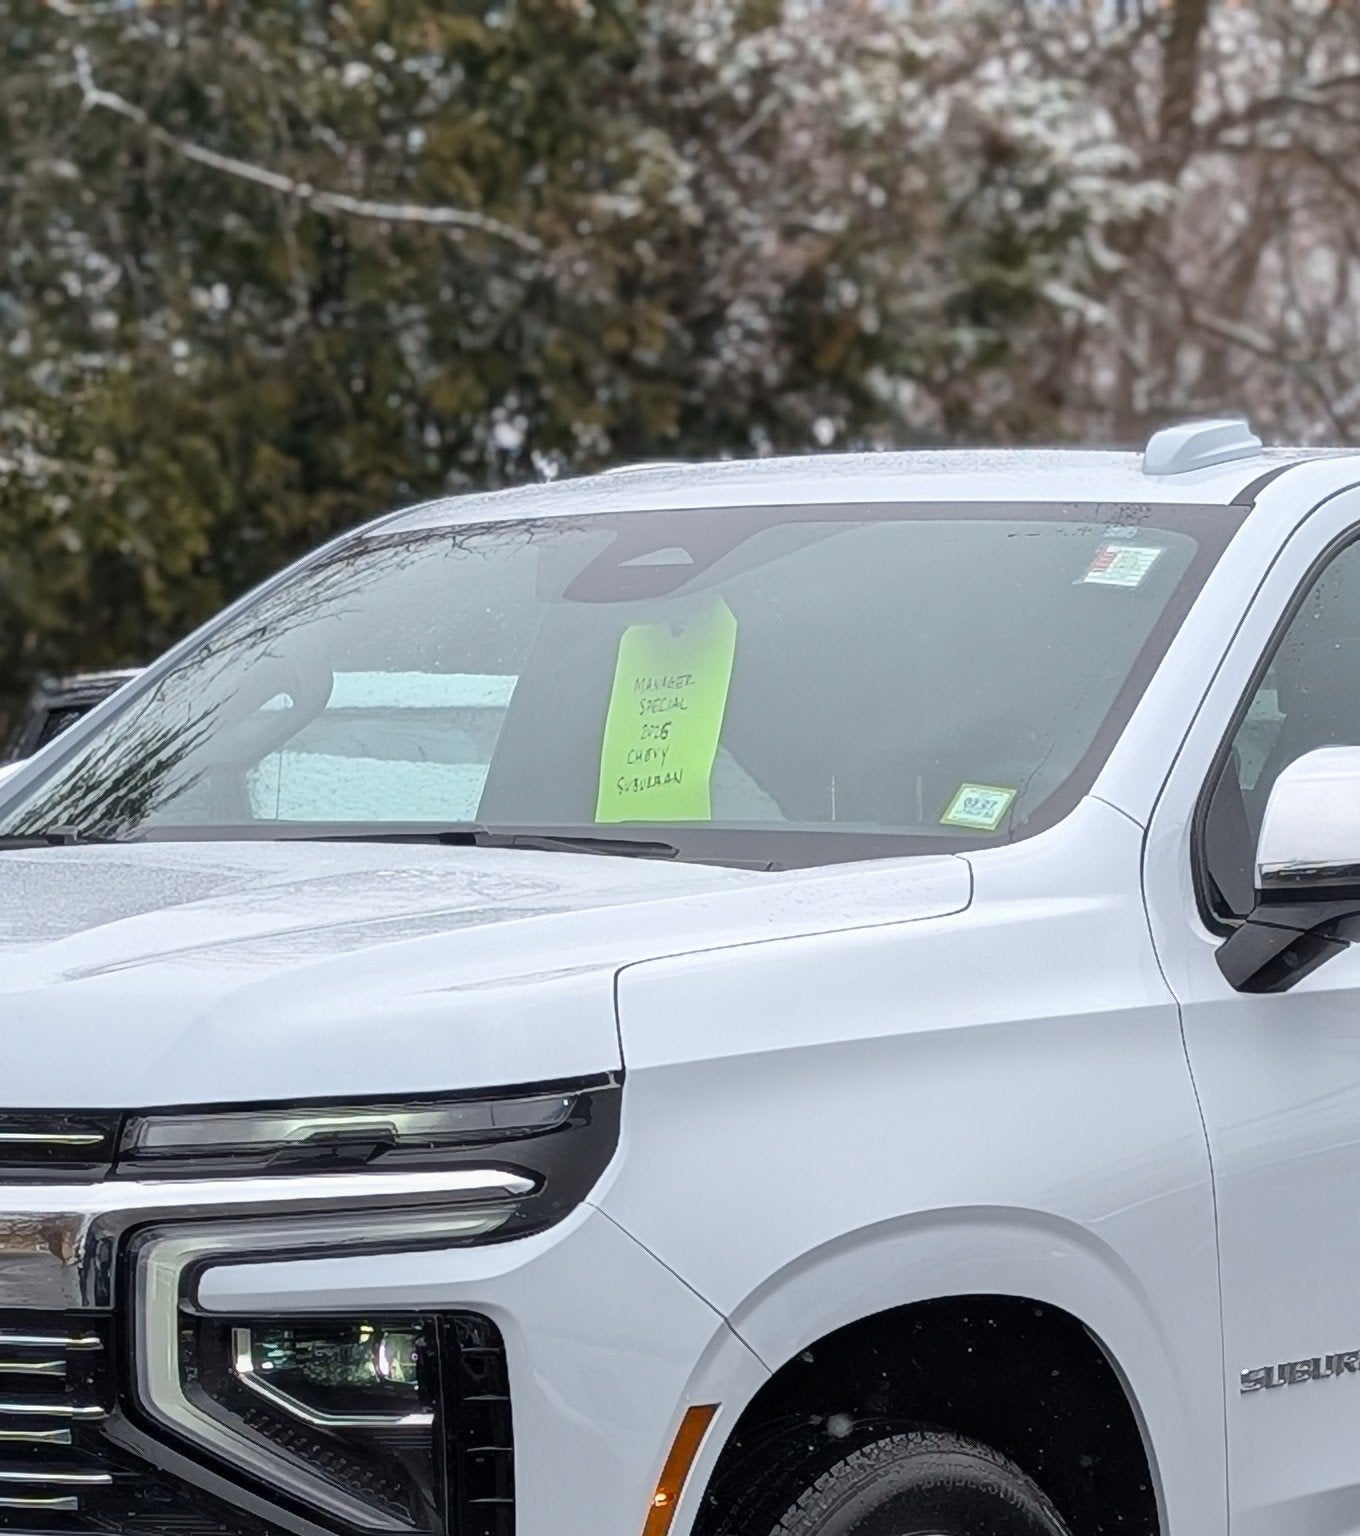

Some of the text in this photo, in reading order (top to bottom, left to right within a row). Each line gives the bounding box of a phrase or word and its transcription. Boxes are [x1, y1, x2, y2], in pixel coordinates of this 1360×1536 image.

[640, 698, 688, 715] SPECIAL
[627, 745, 670, 767] CHEVY
[616, 769, 684, 794] SUBURBAN
